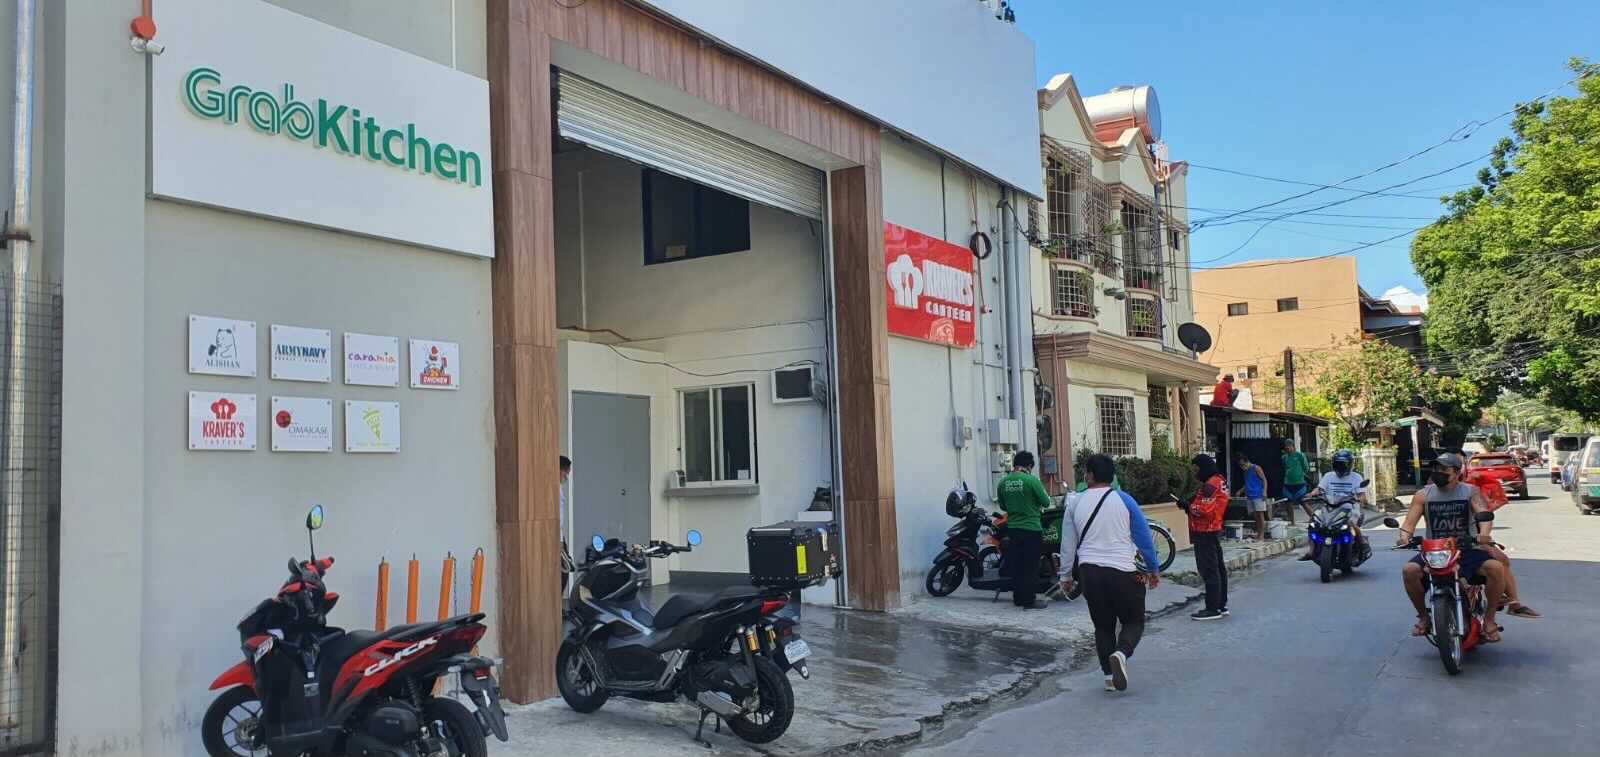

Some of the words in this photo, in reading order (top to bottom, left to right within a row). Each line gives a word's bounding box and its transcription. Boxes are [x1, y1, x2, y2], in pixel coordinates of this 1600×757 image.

[185, 67, 482, 187] GrabKitchen
[925, 301, 972, 322] CANTEEN
[274, 344, 327, 359] ARMYNAVY
[204, 358, 241, 369] ALISHAN
[202, 420, 245, 438] KRAVER'S
[1433, 516, 1465, 531] LOVE
[363, 635, 440, 677] CLICK
